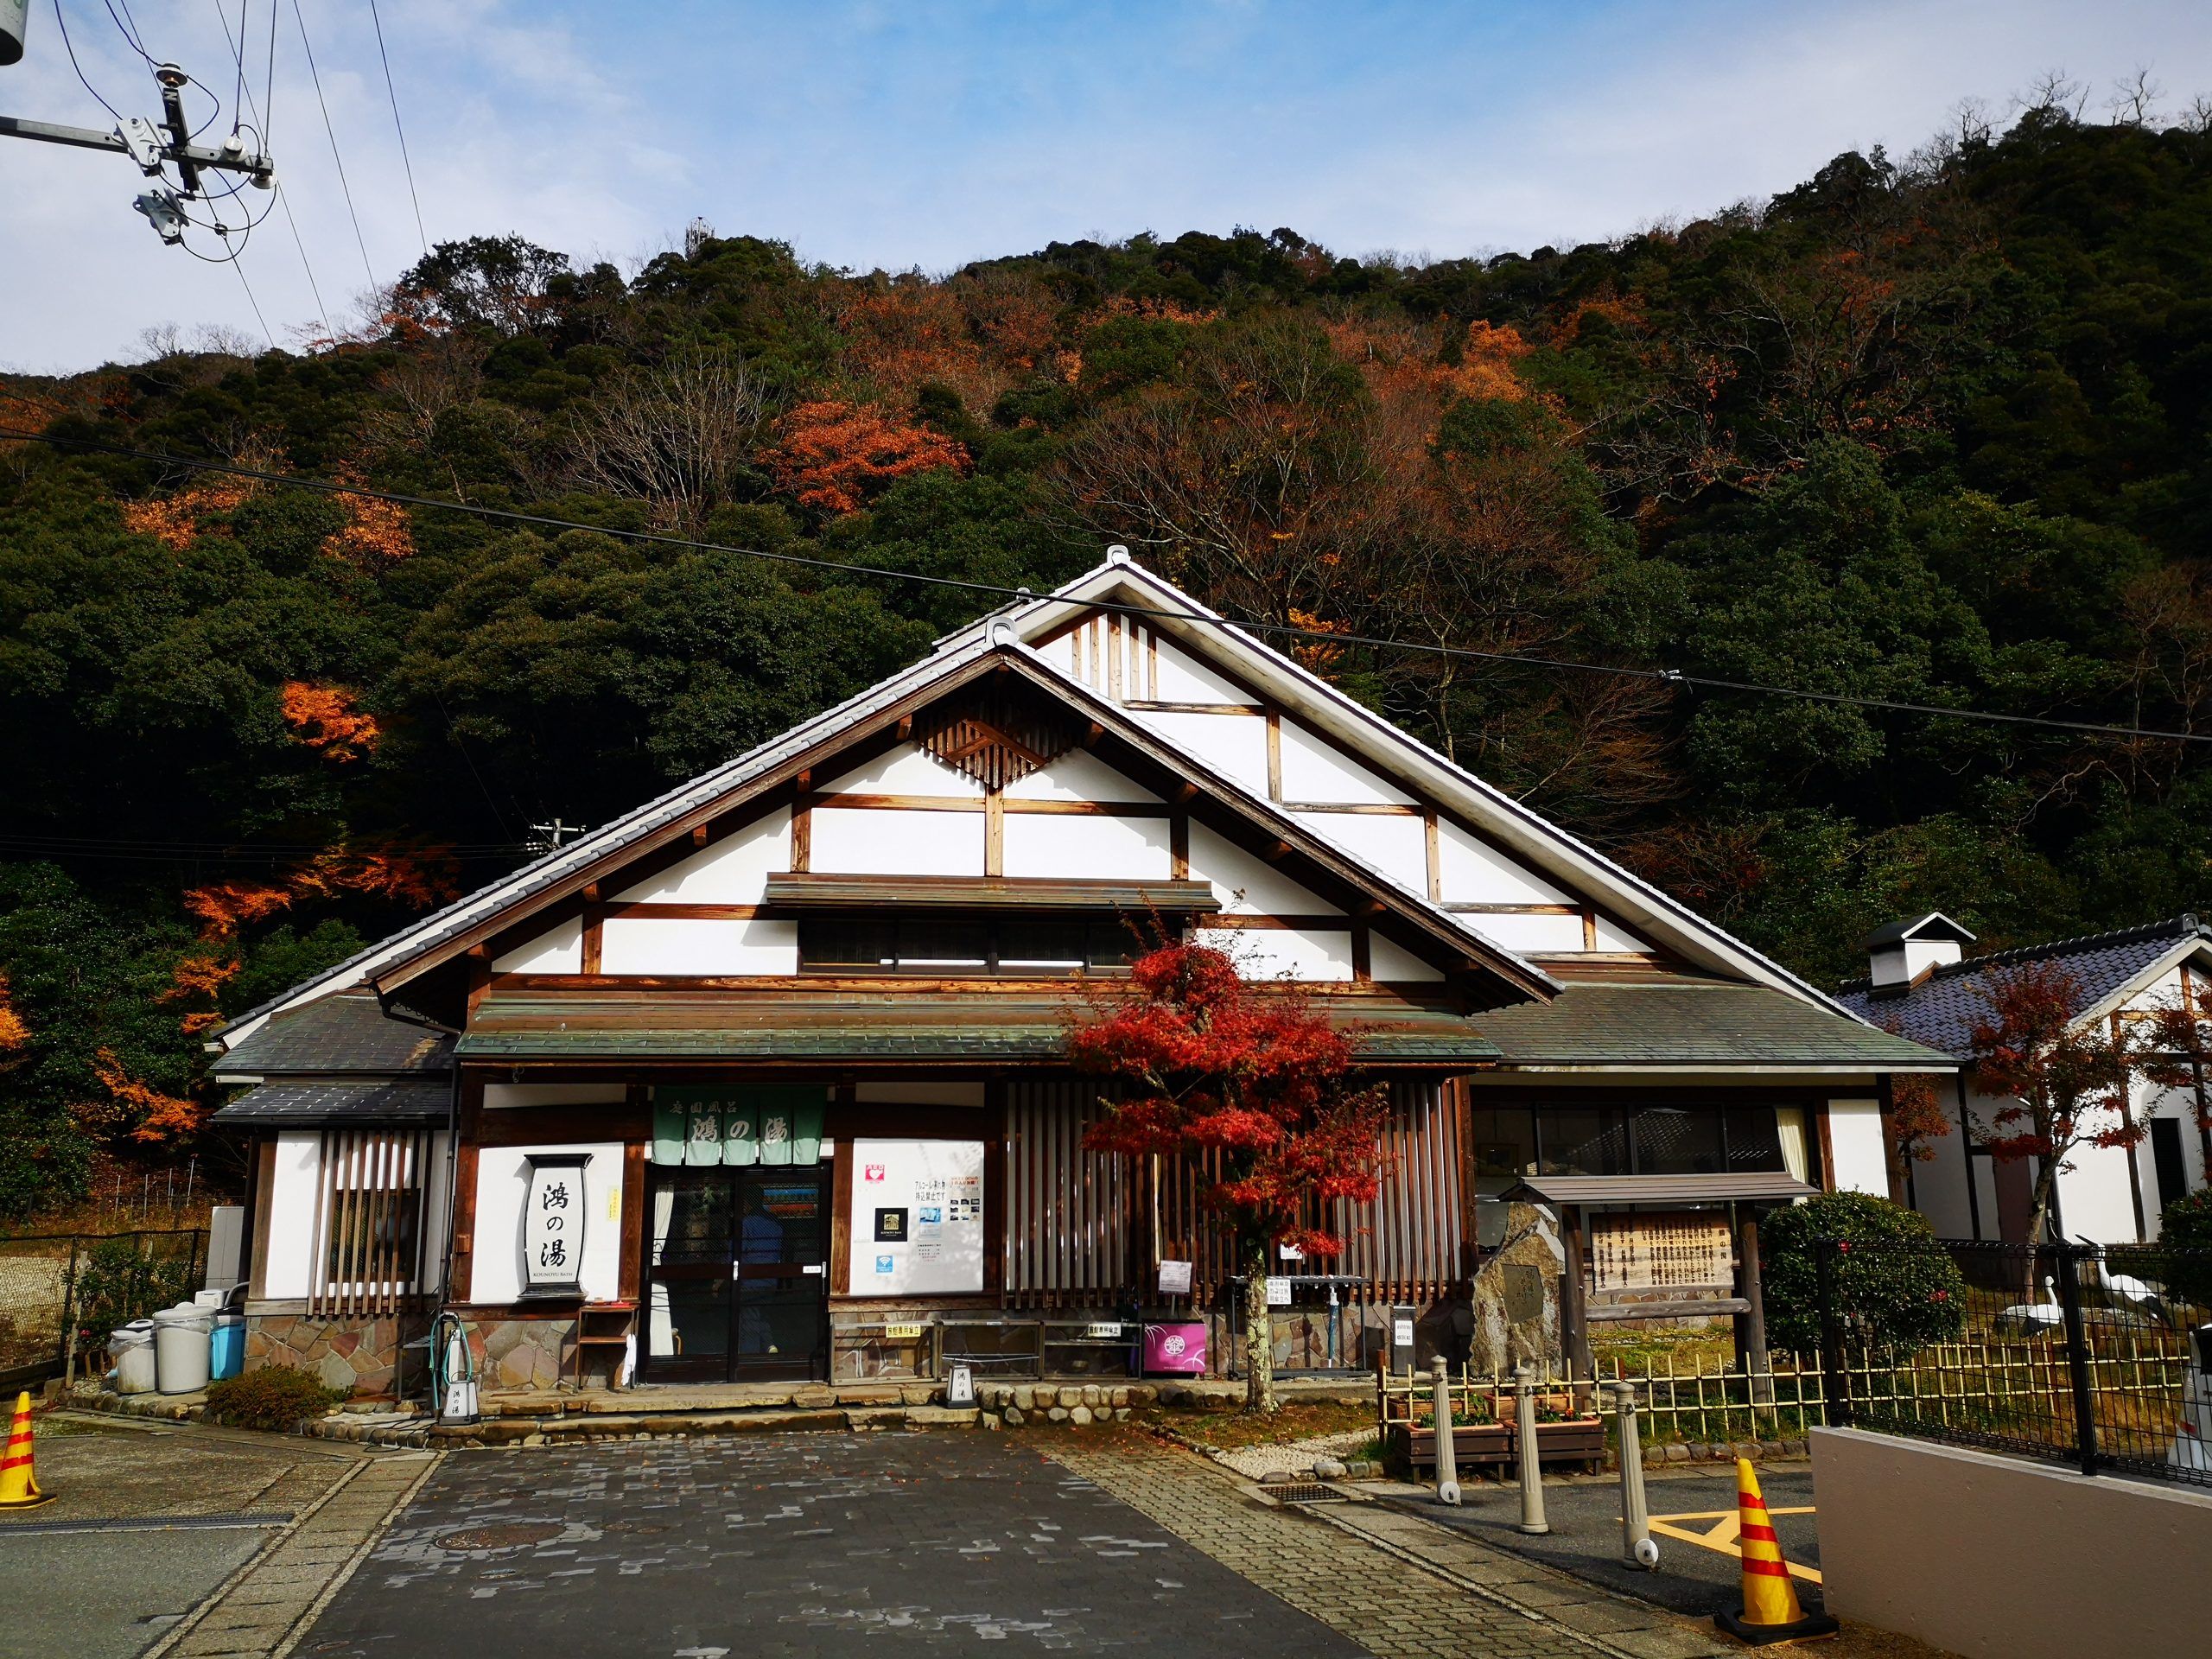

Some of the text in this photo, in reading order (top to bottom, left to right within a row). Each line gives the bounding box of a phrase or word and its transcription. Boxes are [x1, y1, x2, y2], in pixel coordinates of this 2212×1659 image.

[670, 1100, 738, 1115] 庭園風呂
[691, 1115, 788, 1145] 鴻の湯
[916, 1192, 945, 1201] 持込禁止です
[540, 1181, 569, 1268] 鴻の湯
[452, 1389, 461, 1414] 鴻の湯
